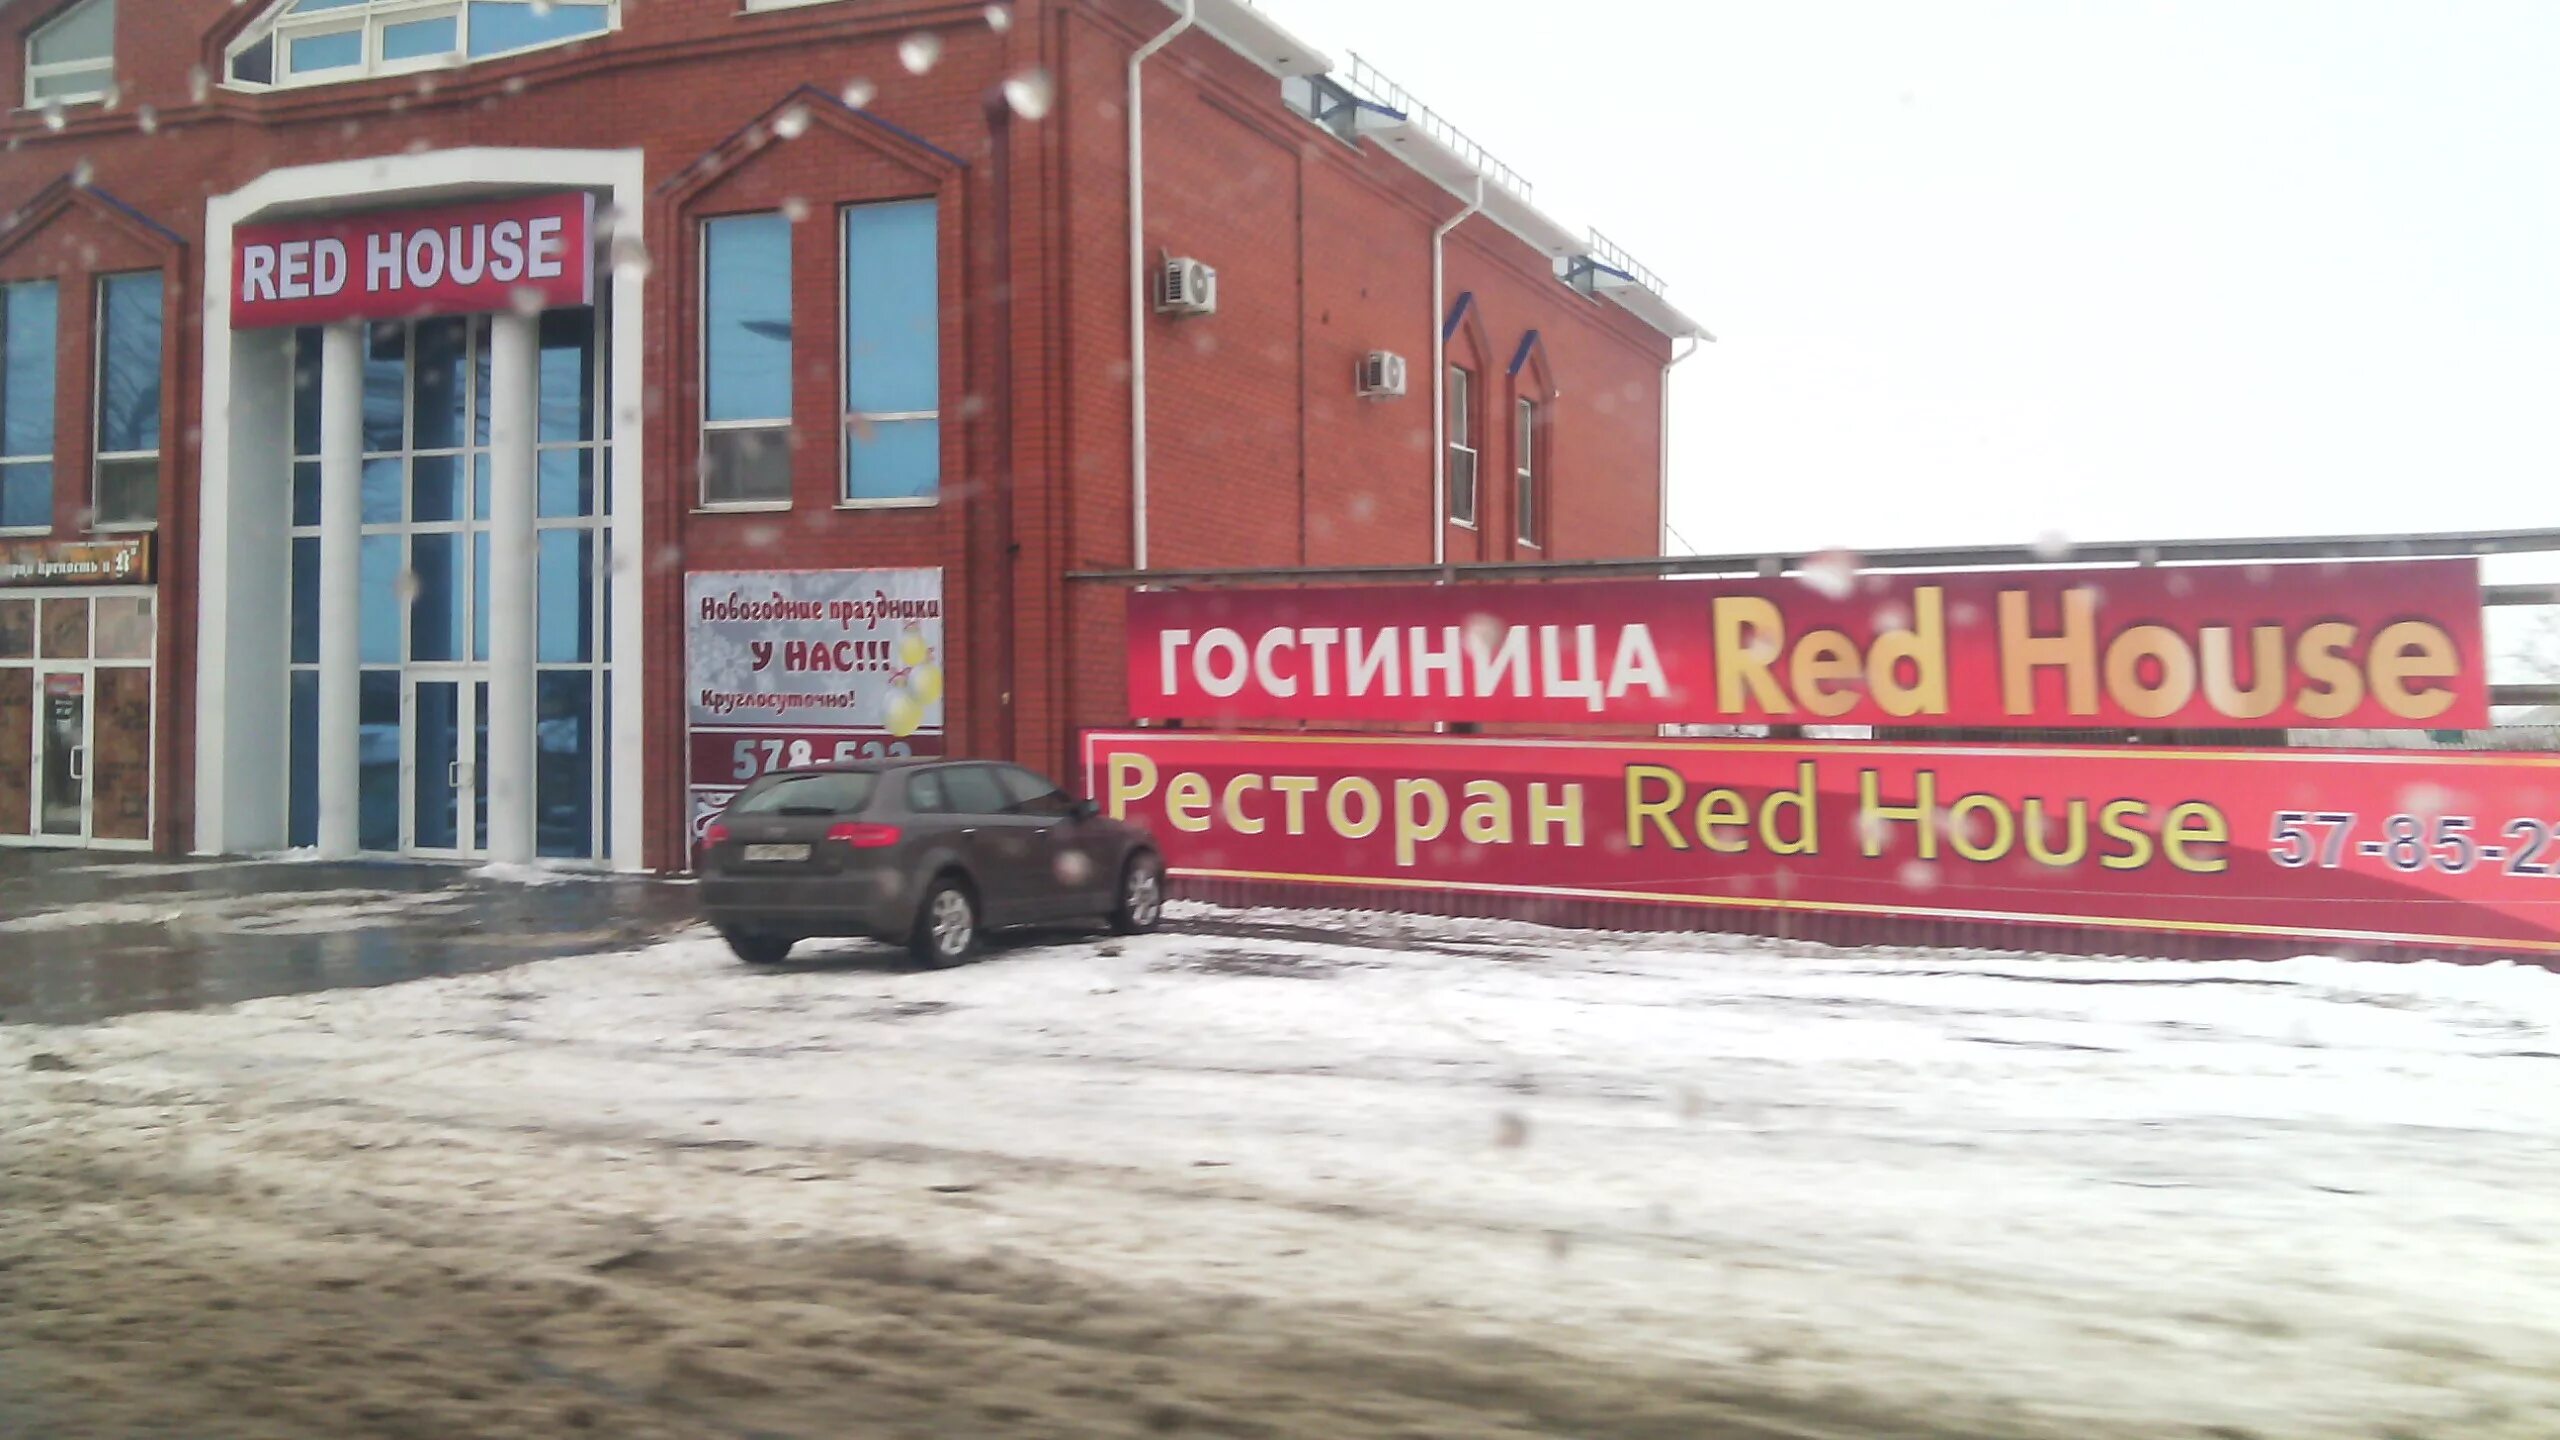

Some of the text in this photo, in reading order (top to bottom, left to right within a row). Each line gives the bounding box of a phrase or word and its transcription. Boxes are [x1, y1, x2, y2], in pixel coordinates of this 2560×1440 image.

[243, 216, 562, 302] RED HOUSE
[701, 589, 940, 630] Новогодние праздники
[751, 640, 891, 672] У НАС!!!
[1160, 586, 2461, 719] ГОСТИНИЦА Red House
[701, 690, 855, 716] Круглосуточно!
[1107, 752, 2560, 877] Ресторан Red House 57-85-2
